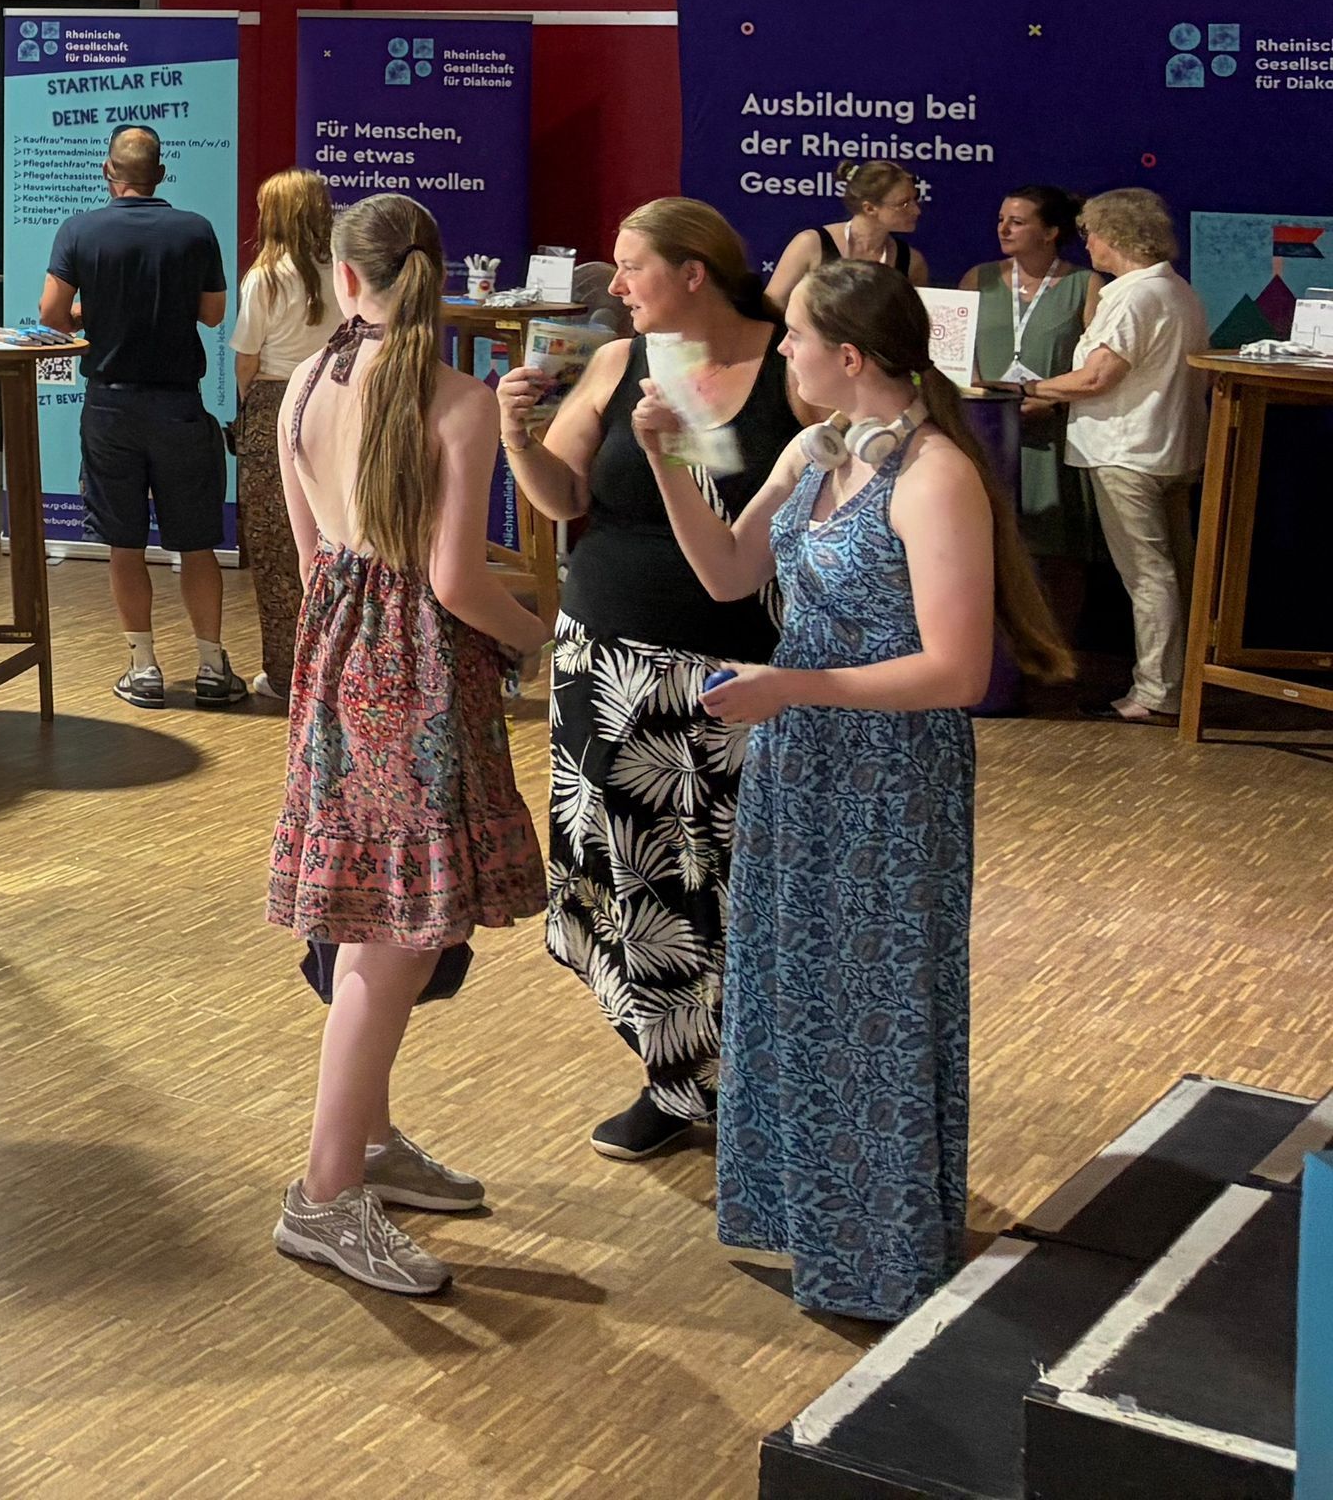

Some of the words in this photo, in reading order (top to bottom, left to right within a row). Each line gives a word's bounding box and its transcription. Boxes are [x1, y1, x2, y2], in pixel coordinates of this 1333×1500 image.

[65, 30, 121, 40] Rheinische
[65, 42, 129, 52] Gesellschaft
[65, 53, 79, 63] für
[83, 53, 126, 63] Diakonie
[443, 50, 506, 61] Rheinische
[443, 63, 514, 74] Gesellschaft
[48, 74, 144, 95] STARTKLAR
[151, 66, 183, 87] FÜR
[443, 76, 460, 87] für
[463, 77, 512, 88] Diakonie
[1255, 75, 1281, 89] für
[53, 109, 98, 126] DEINE
[105, 102, 189, 123] ZUKUNFT?
[741, 91, 914, 124] Ausbildung
[926, 94, 976, 120] bei
[316, 120, 348, 138] Für
[355, 122, 462, 144] Menschen,
[740, 130, 792, 155] der
[802, 132, 994, 162] Rheinischen
[316, 145, 347, 162] die
[353, 149, 415, 164] etwas
[417, 173, 485, 191] wollen
